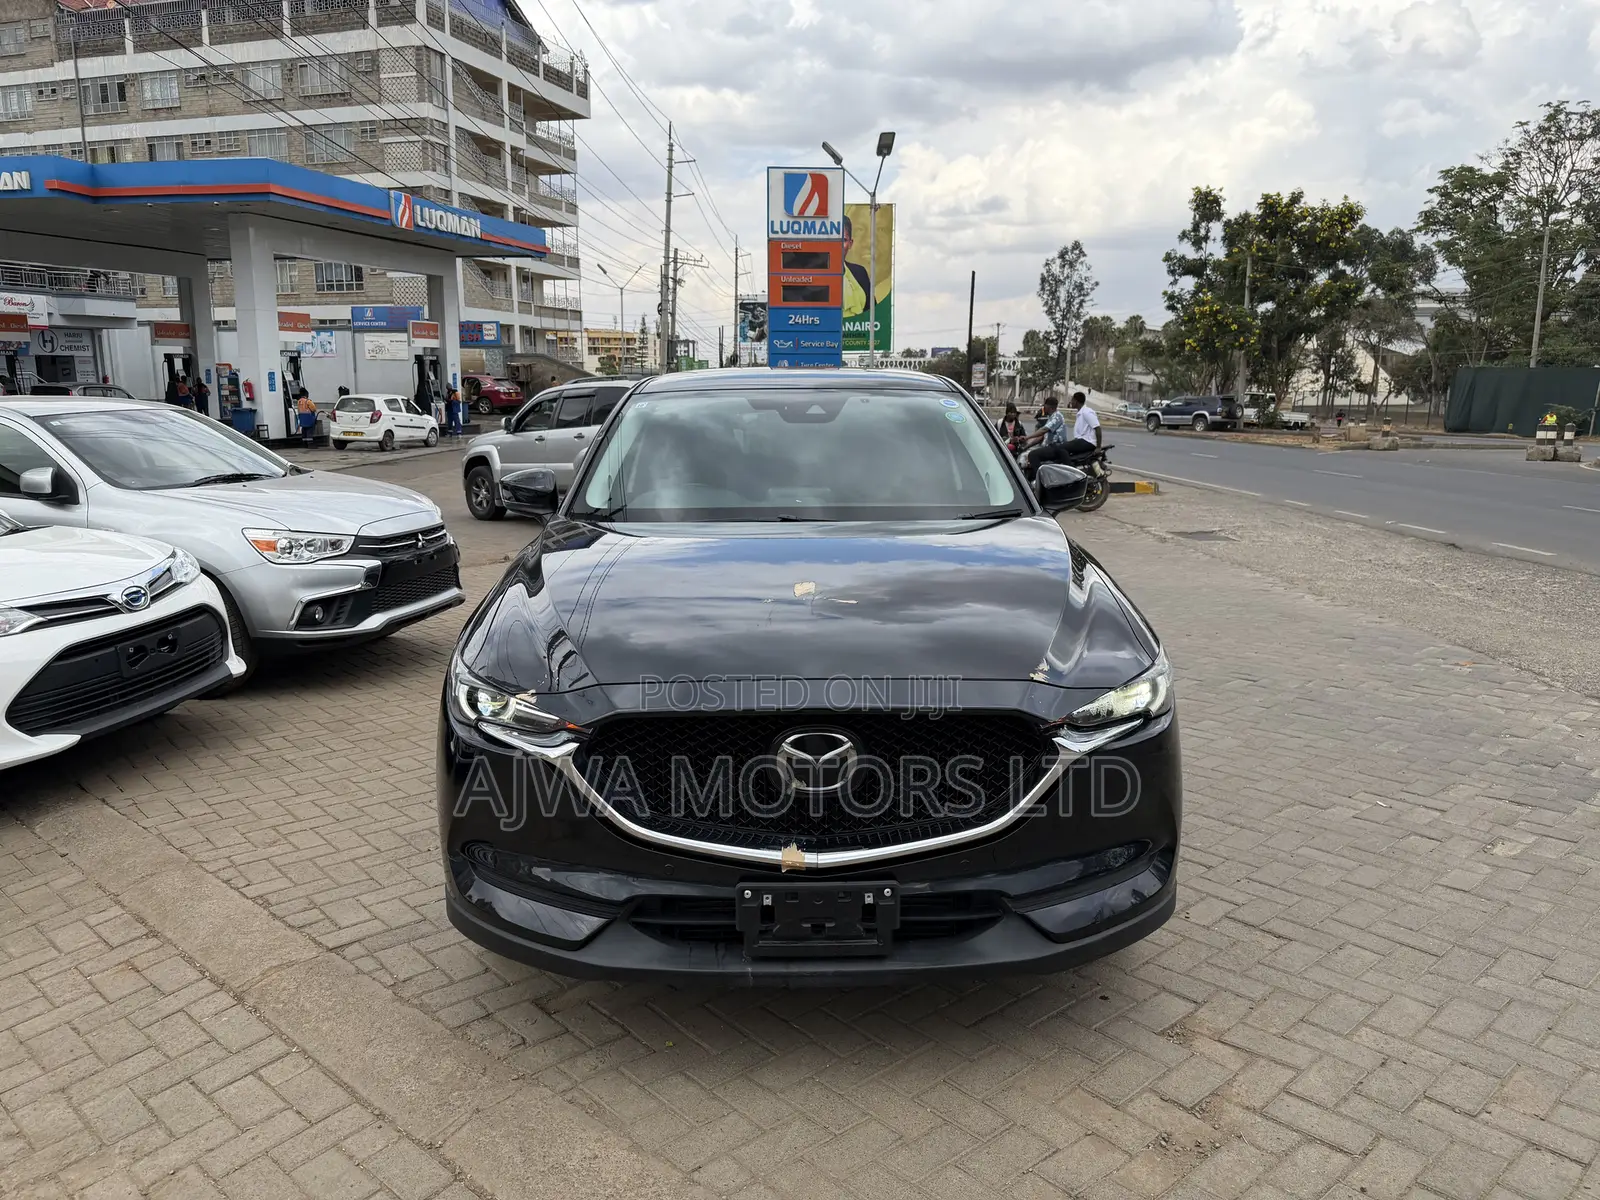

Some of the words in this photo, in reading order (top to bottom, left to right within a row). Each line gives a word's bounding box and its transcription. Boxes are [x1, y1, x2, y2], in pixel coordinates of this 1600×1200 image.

[414, 204, 480, 238] LUQMAN
[770, 220, 841, 235] LUQMAN
[788, 314, 820, 325] 24Hrs
[826, 340, 839, 348] Bay
